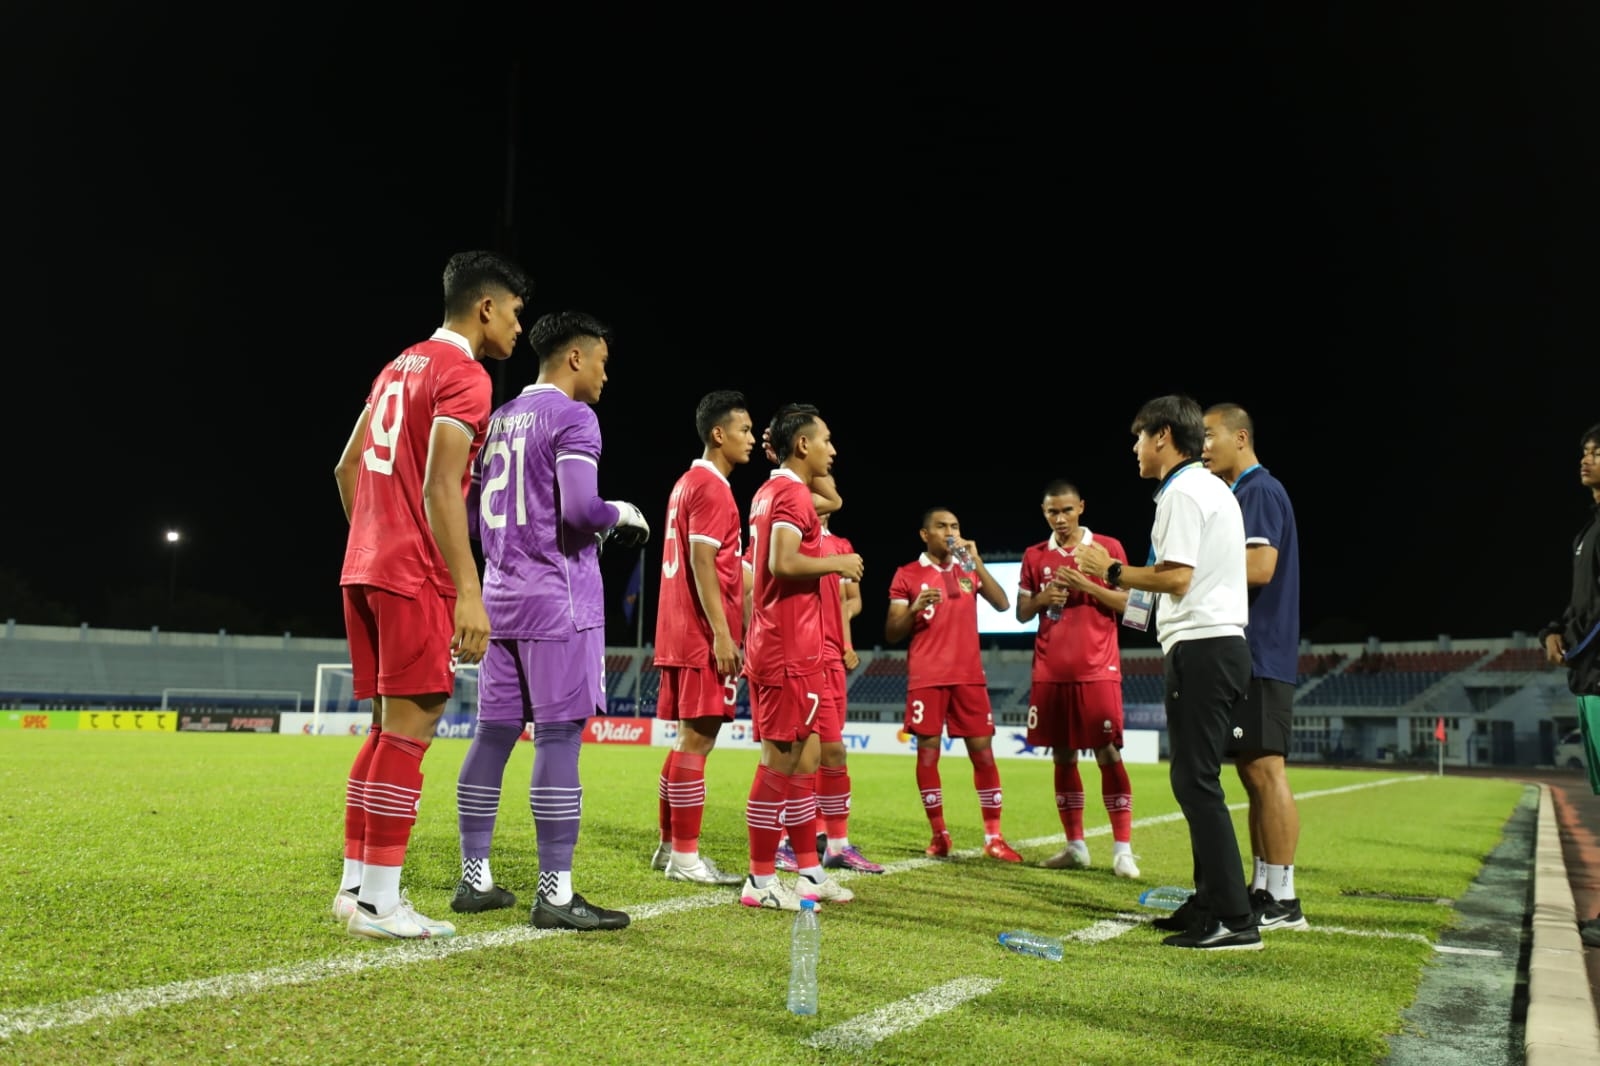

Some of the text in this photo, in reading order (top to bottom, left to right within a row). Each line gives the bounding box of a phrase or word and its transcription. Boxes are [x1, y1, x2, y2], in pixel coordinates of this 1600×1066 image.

[364, 381, 404, 475] 9
[481, 437, 526, 529] 21
[724, 677, 738, 706] 5
[805, 692, 819, 726] 7
[911, 700, 925, 724] 3
[591, 720, 644, 741] Vidio
